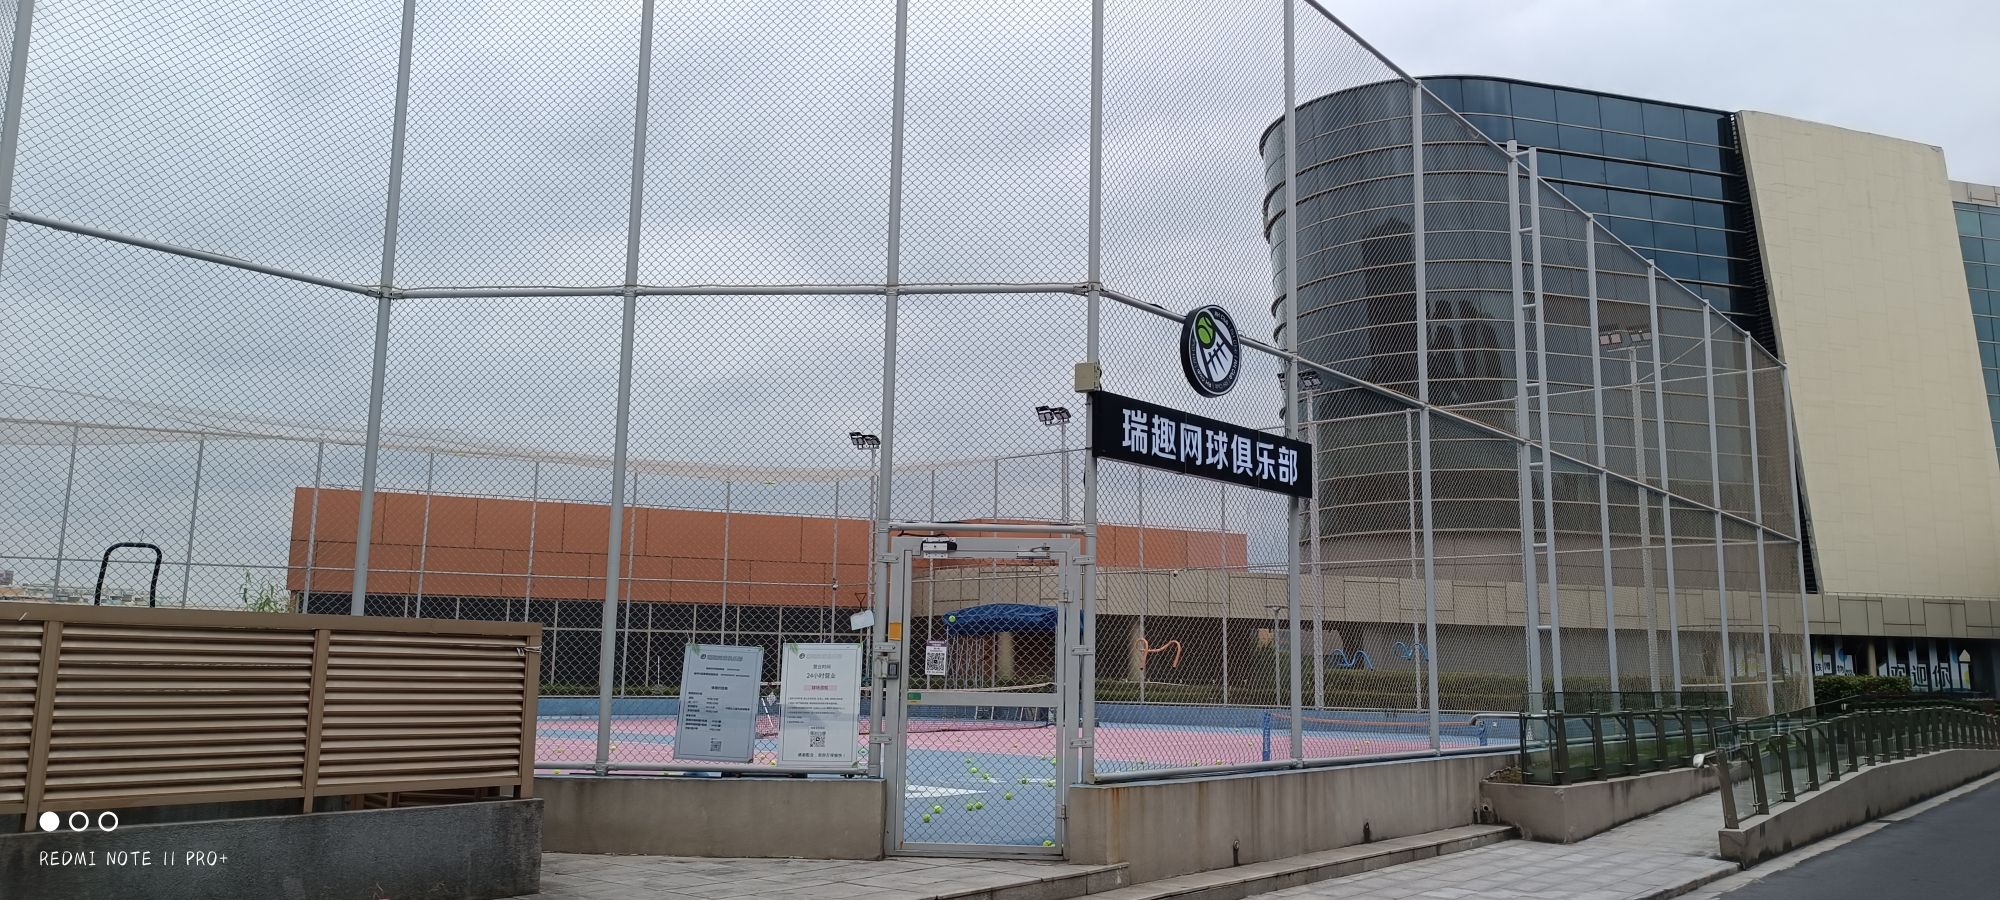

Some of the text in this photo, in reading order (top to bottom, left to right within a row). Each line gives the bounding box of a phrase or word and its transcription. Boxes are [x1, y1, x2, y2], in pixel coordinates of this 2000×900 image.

[1122, 408, 1298, 486] 瑞趣网球俱乐部
